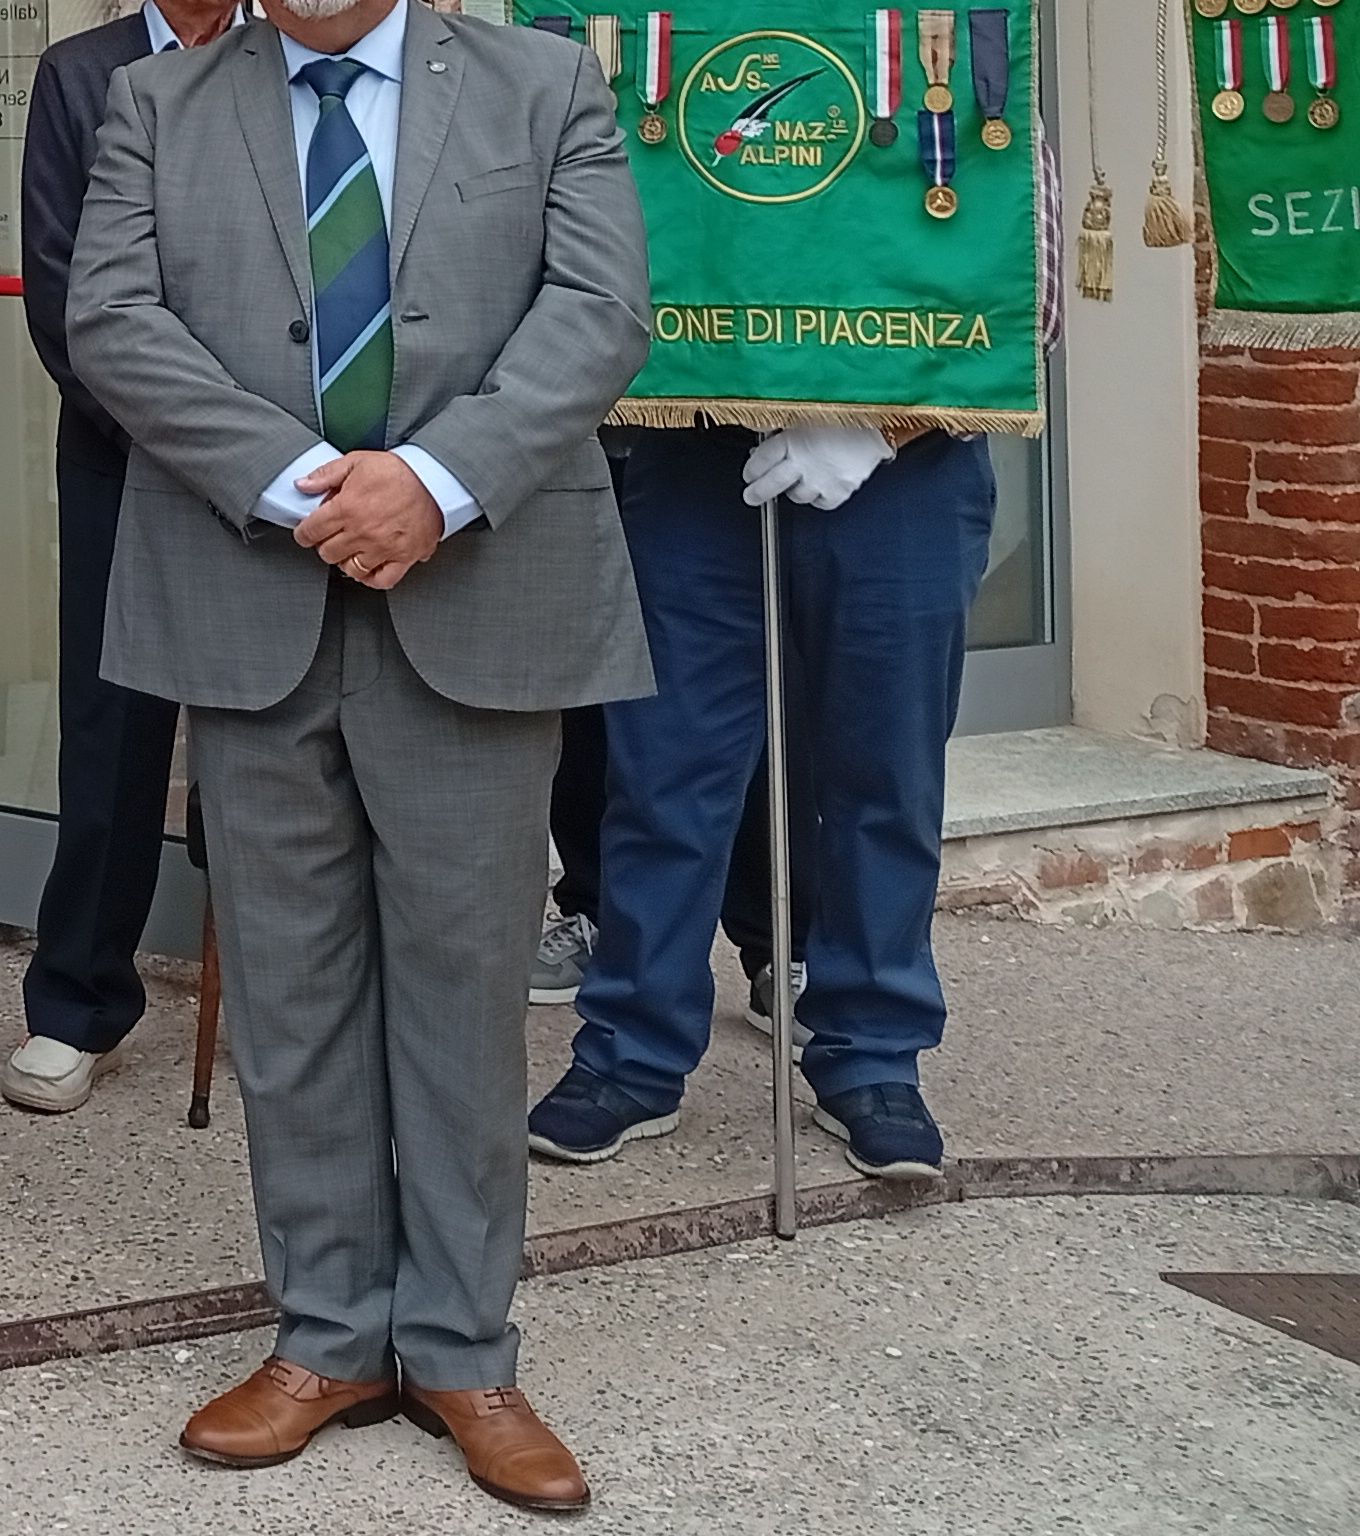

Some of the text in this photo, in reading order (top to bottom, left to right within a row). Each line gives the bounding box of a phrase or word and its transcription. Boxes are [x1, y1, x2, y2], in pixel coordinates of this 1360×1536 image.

[739, 144, 823, 167] ALPINI
[650, 306, 993, 350] ONE DI PIACENZA
